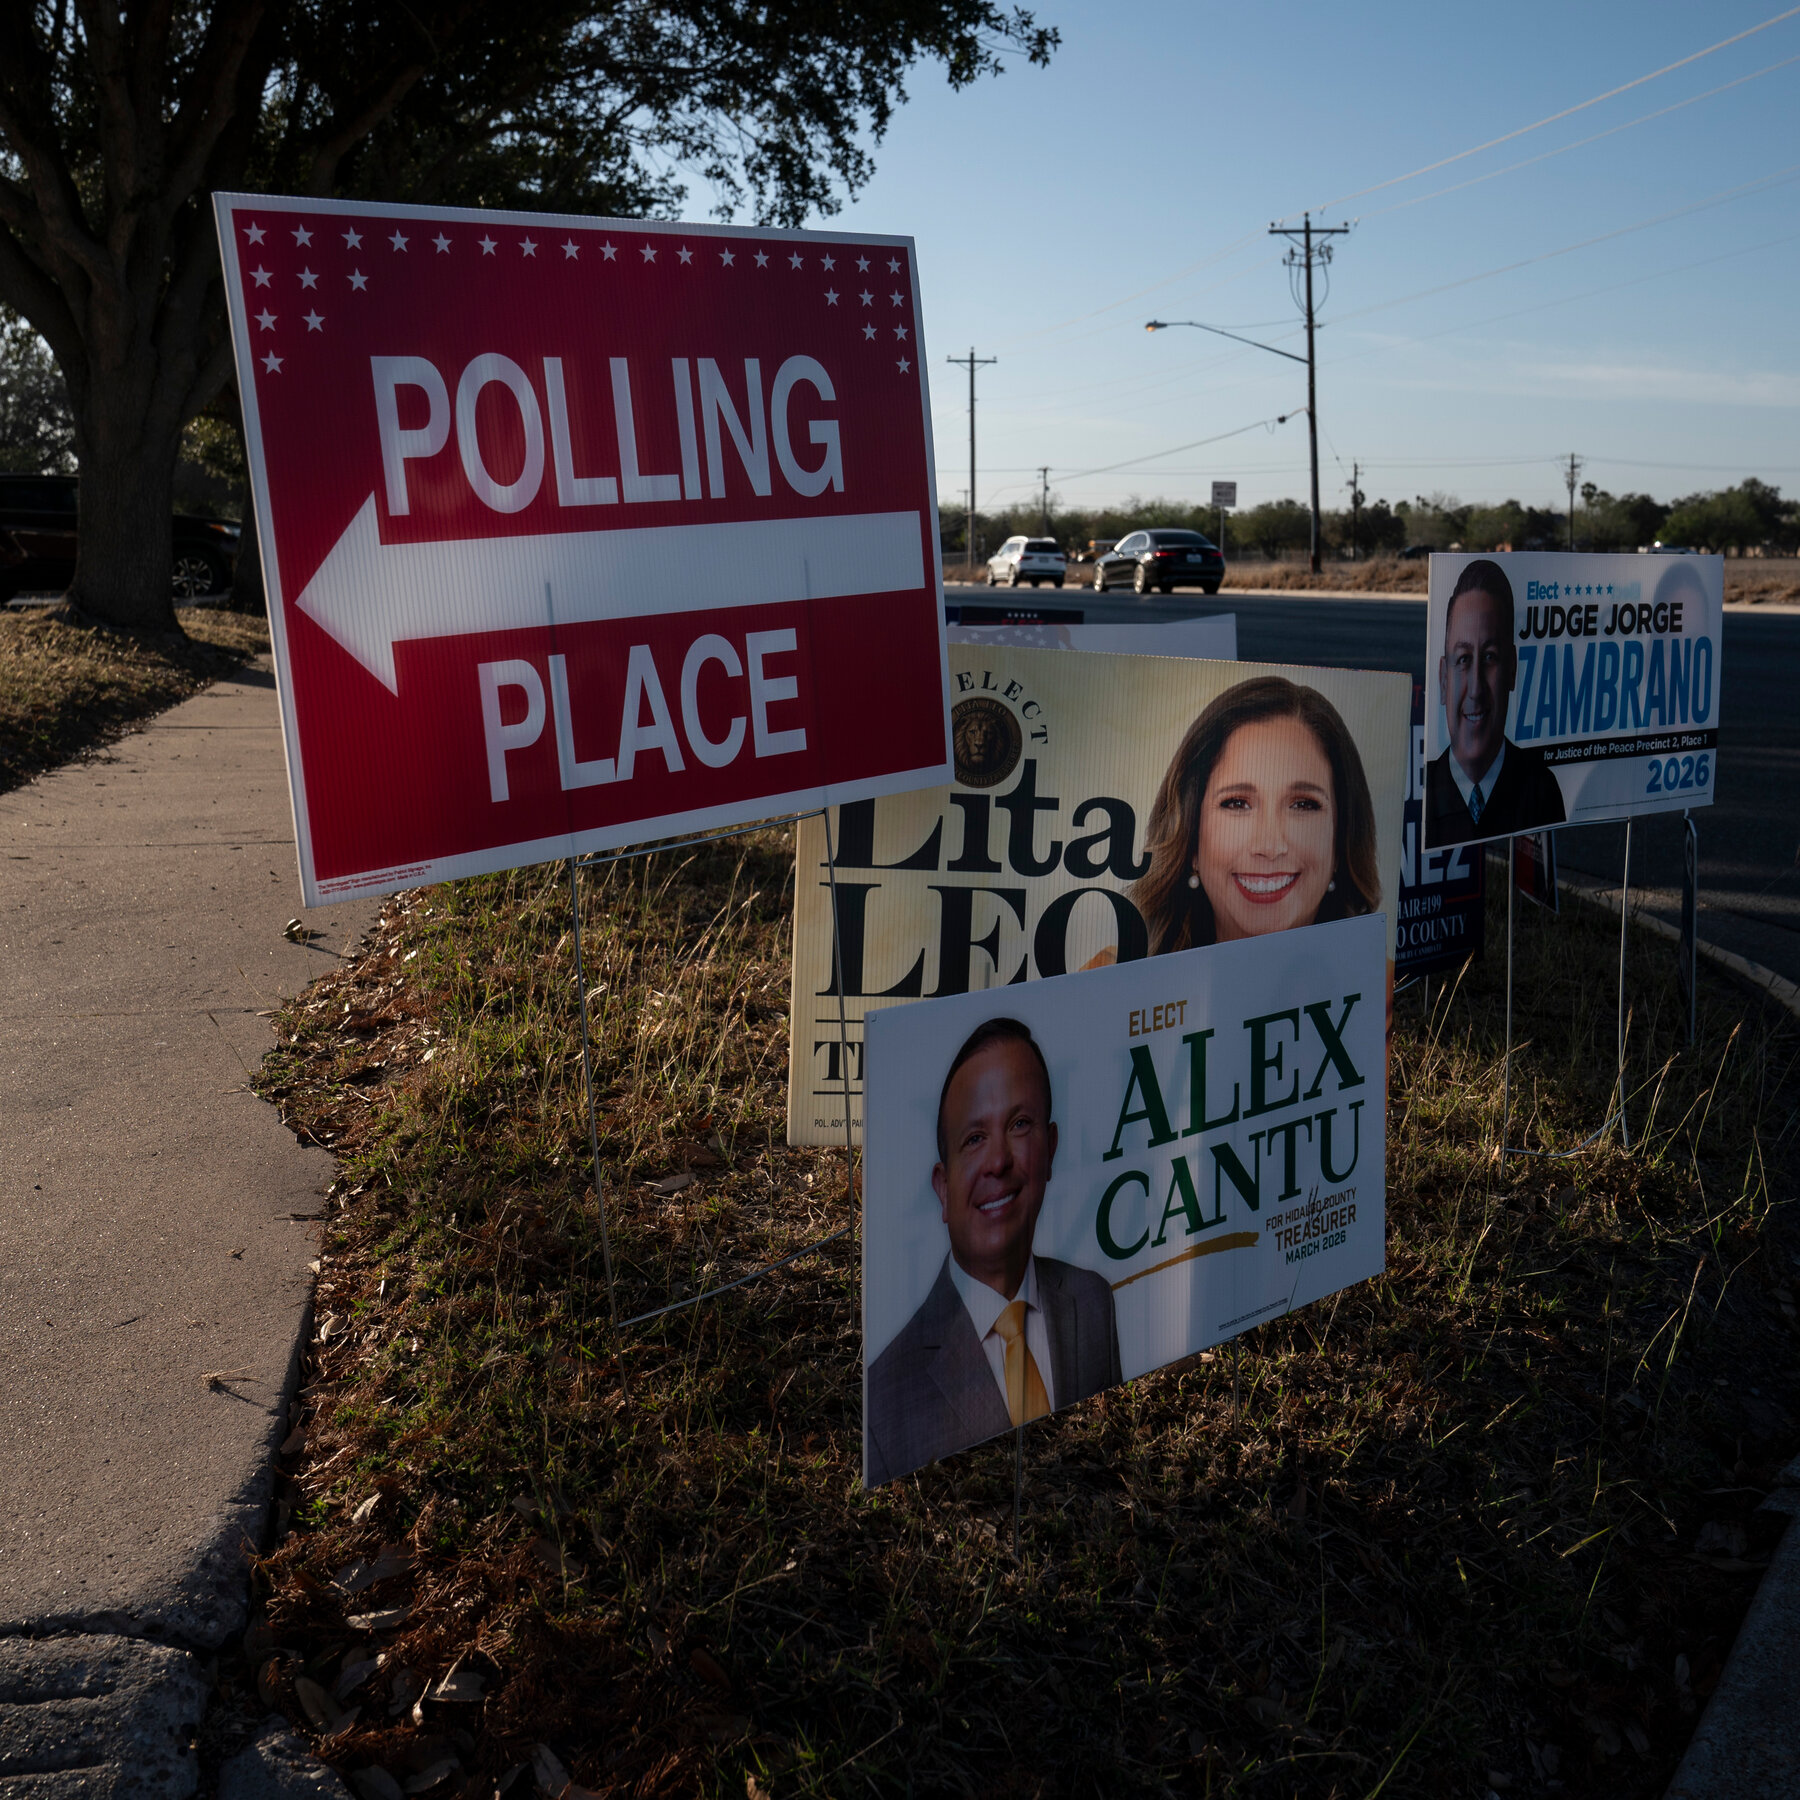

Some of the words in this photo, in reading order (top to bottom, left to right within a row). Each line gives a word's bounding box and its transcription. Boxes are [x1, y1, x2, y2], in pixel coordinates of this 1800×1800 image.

[370, 352, 845, 516] POLLING
[1527, 580, 1559, 600] Elect
[1519, 604, 1598, 640] JUDGE
[1604, 602, 1683, 635] JORGE
[955, 671, 1048, 744] ELECT
[1515, 636, 1713, 742] ZAMBRANO
[478, 628, 807, 803] PLACE
[1544, 751, 1554, 760] for
[1555, 746, 1582, 760] Justice
[1584, 745, 1592, 756] of
[1593, 743, 1607, 755] the
[1609, 741, 1635, 753] Peace
[1636, 738, 1670, 751] Precinct
[1672, 738, 1680, 750] 2,
[1681, 735, 1701, 747] Place
[1703, 734, 1708, 744] 1
[1646, 753, 1710, 793] 2026
[820, 759, 1153, 881] Lita
[815, 882, 1149, 998] LEO
[1409, 913, 1467, 945] COUNTY
[1129, 999, 1188, 1037] ELECT
[1102, 992, 1365, 1162] ALEX
[814, 1119, 829, 1128] POL.
[1096, 1100, 1364, 1260] CANTU
[1266, 1214, 1283, 1231] FOR
[1286, 1199, 1321, 1224] HIDALGO
[1324, 1187, 1357, 1209] COUNTY
[1275, 1203, 1356, 1252] TREASURER
[1286, 1240, 1319, 1265] MARCH
[1323, 1230, 1346, 1250] 2026
